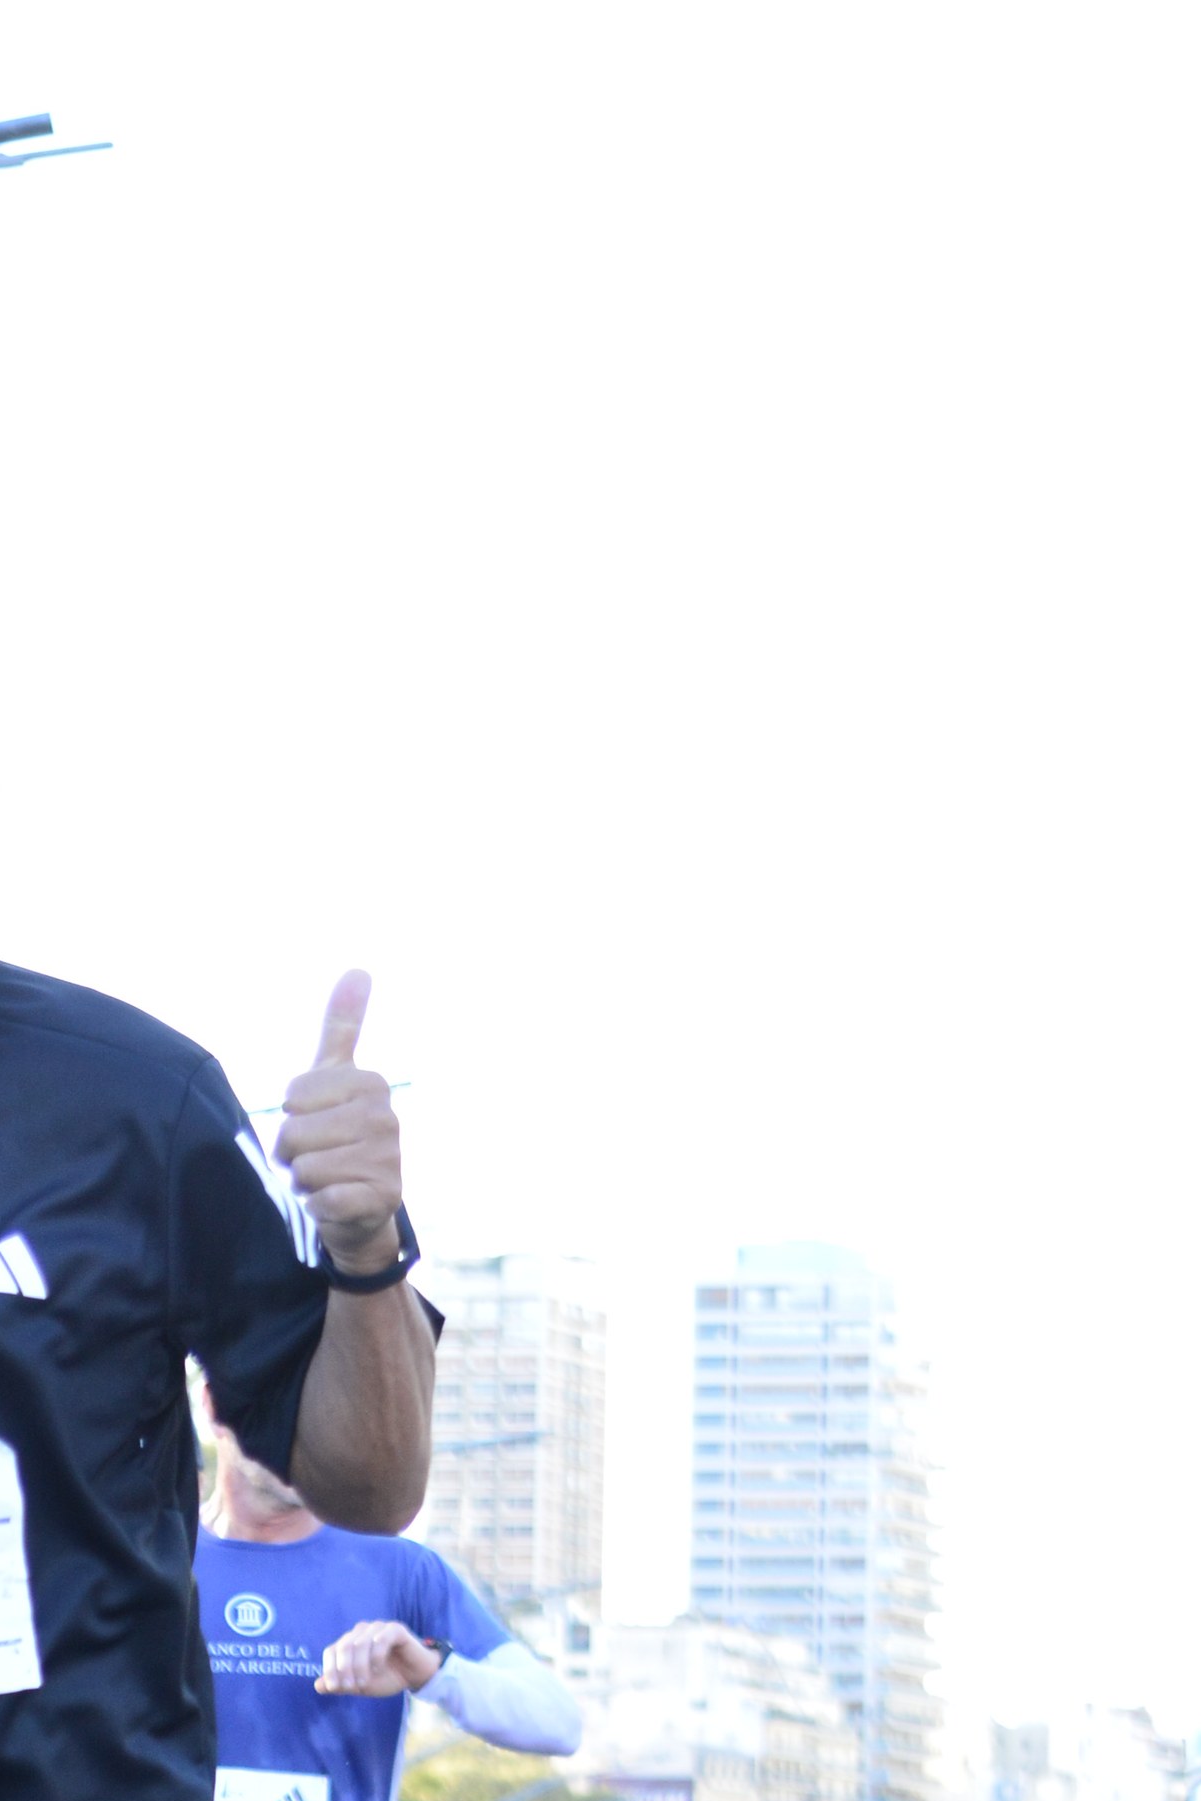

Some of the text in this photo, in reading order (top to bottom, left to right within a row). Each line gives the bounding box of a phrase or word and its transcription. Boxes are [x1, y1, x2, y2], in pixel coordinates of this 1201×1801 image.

[207, 1642, 308, 1660] ANCO DE LA
[236, 1660, 323, 1677] ARGENTIN
